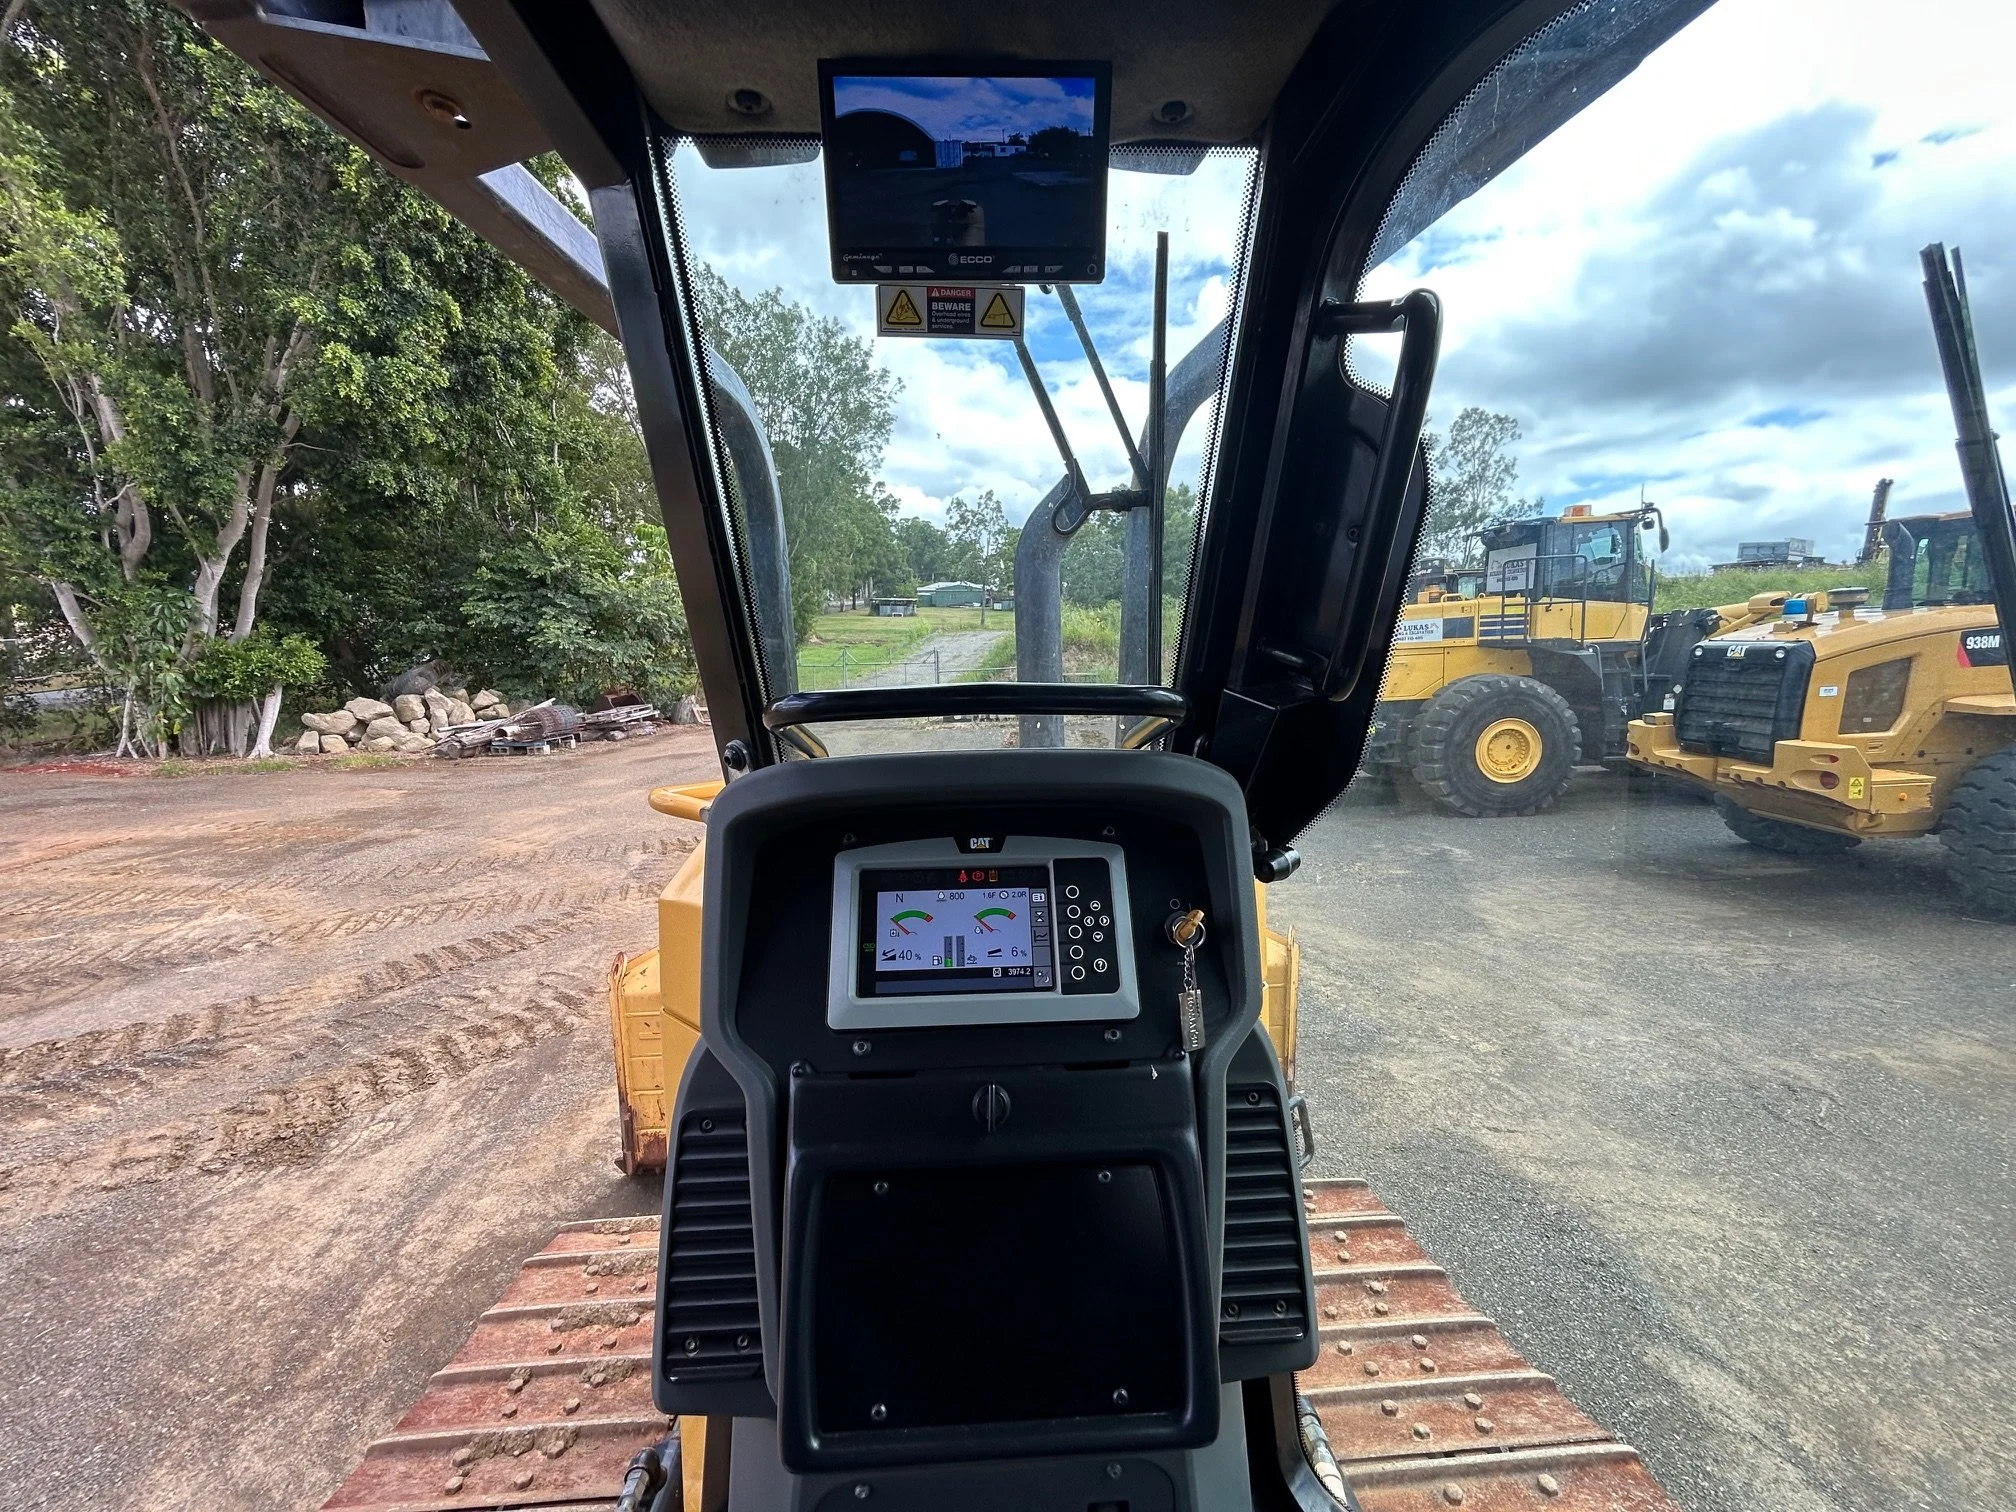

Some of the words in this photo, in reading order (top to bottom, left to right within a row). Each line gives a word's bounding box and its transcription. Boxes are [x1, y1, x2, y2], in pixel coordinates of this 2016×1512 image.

[940, 289, 972, 297] DANGER
[931, 302, 971, 311] BEWARE
[1966, 635, 2000, 649] 938M
[1727, 645, 1749, 657] CAT
[970, 837, 990, 848] CAT
[896, 893, 904, 903] N
[949, 892, 965, 900] 800
